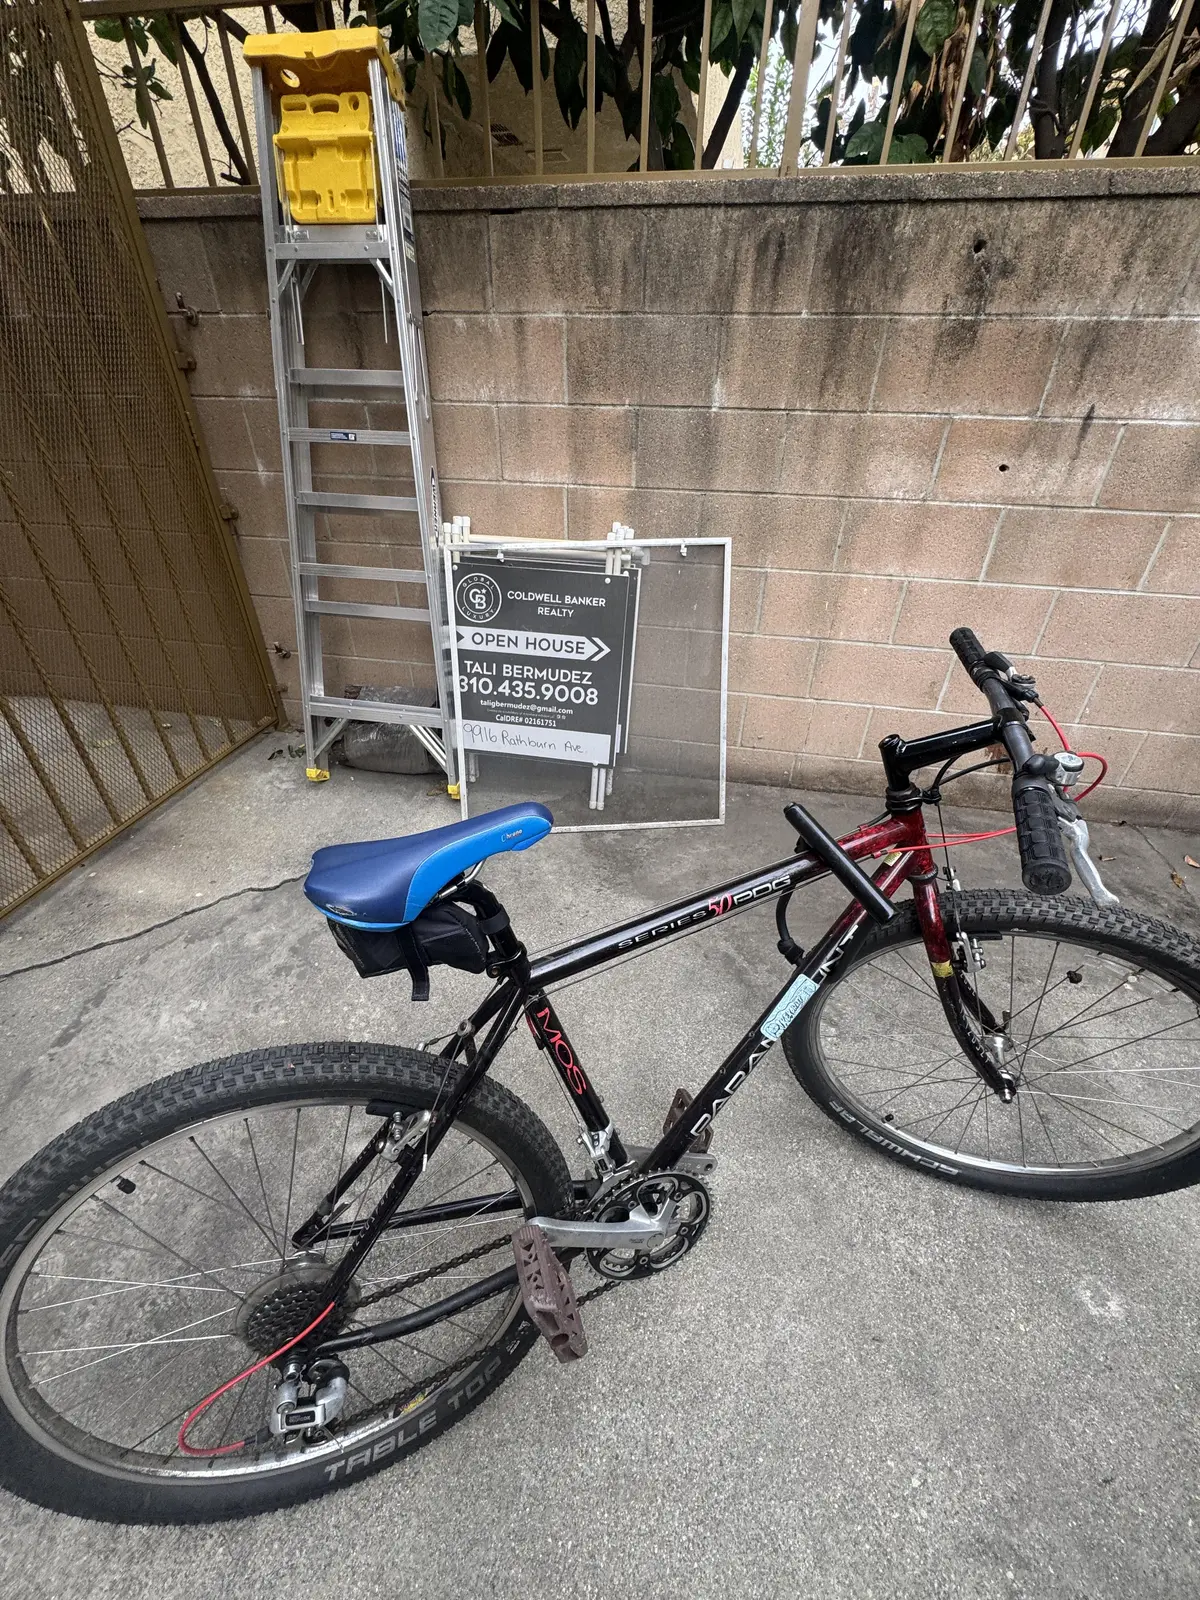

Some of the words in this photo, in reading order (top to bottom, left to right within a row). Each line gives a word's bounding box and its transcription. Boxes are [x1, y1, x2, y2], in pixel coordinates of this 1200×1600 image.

[507, 590, 562, 604] COLDWELL
[564, 595, 606, 607] BANKER
[461, 606, 496, 620] LUXURY
[537, 607, 574, 618] REALTY
[471, 632, 518, 648] OPEN
[525, 636, 586, 655] HOUSE
[463, 660, 496, 676] TALI
[502, 664, 593, 685] BERMUDEZ
[459, 675, 599, 706] 310.435.9008
[480, 699, 574, 715] taligbermudez@gmail.com
[495, 714, 523, 723] CalDRE#
[524, 716, 557, 727] 02161751
[463, 723, 498, 744] 9916
[501, 729, 557, 750] Rathburn
[618, 910, 707, 949] SERIES
[708, 893, 733, 916] 50
[733, 875, 792, 906] PDG
[536, 1007, 587, 1095] MOS
[324, 1409, 438, 1482] TABLE
[447, 1356, 502, 1411] TOP
